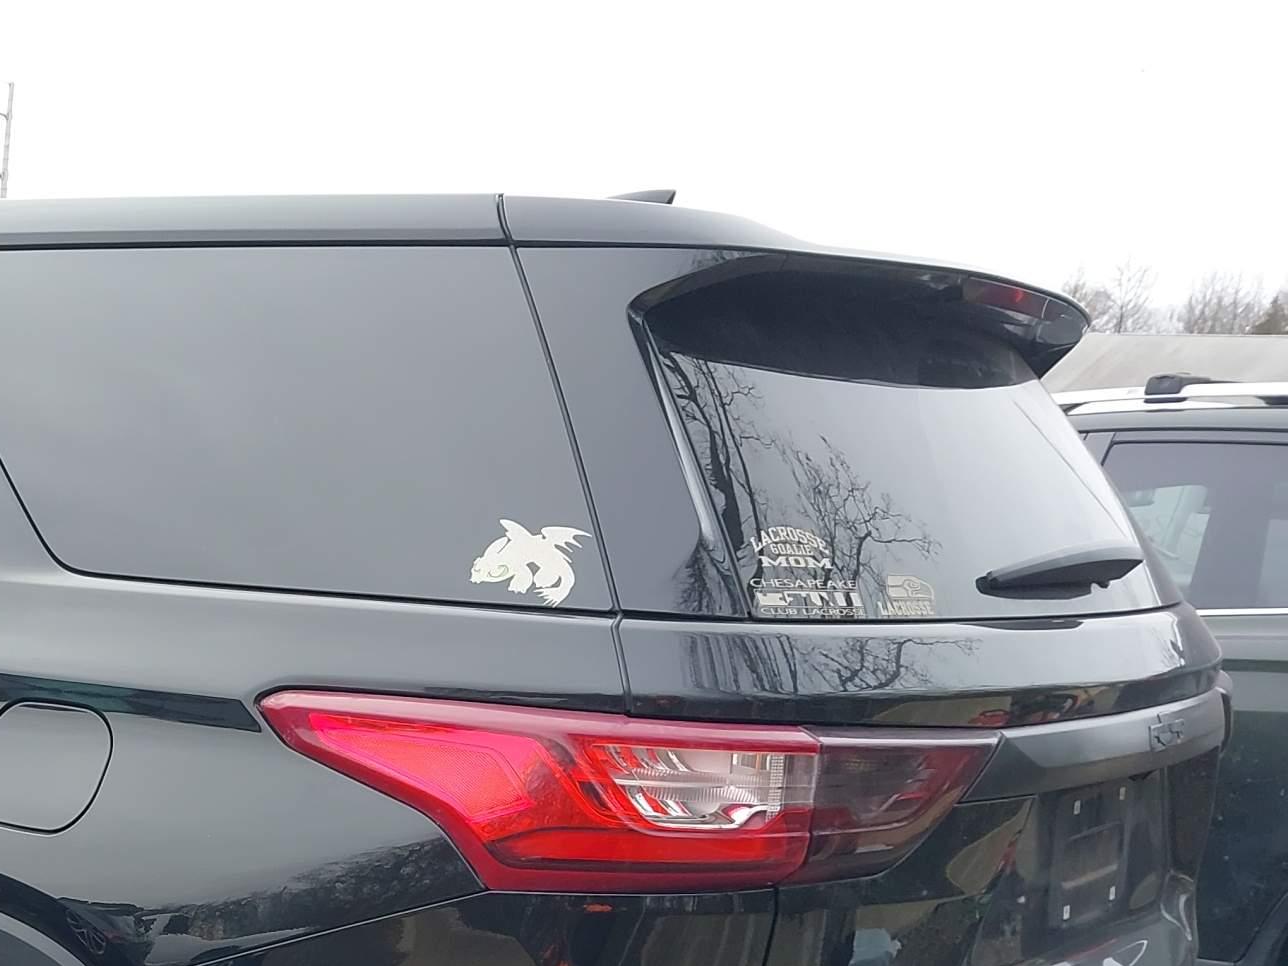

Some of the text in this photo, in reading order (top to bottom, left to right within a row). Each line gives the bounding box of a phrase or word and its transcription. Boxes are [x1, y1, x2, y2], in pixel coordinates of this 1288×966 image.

[750, 526, 830, 556] LACROSSE
[769, 543, 813, 555] GOALIE
[758, 555, 833, 569] MOM
[750, 578, 857, 590] CHESAPEAKE
[760, 607, 866, 617] CLUB LACROSSE
[877, 600, 935, 616] LACROSSE
